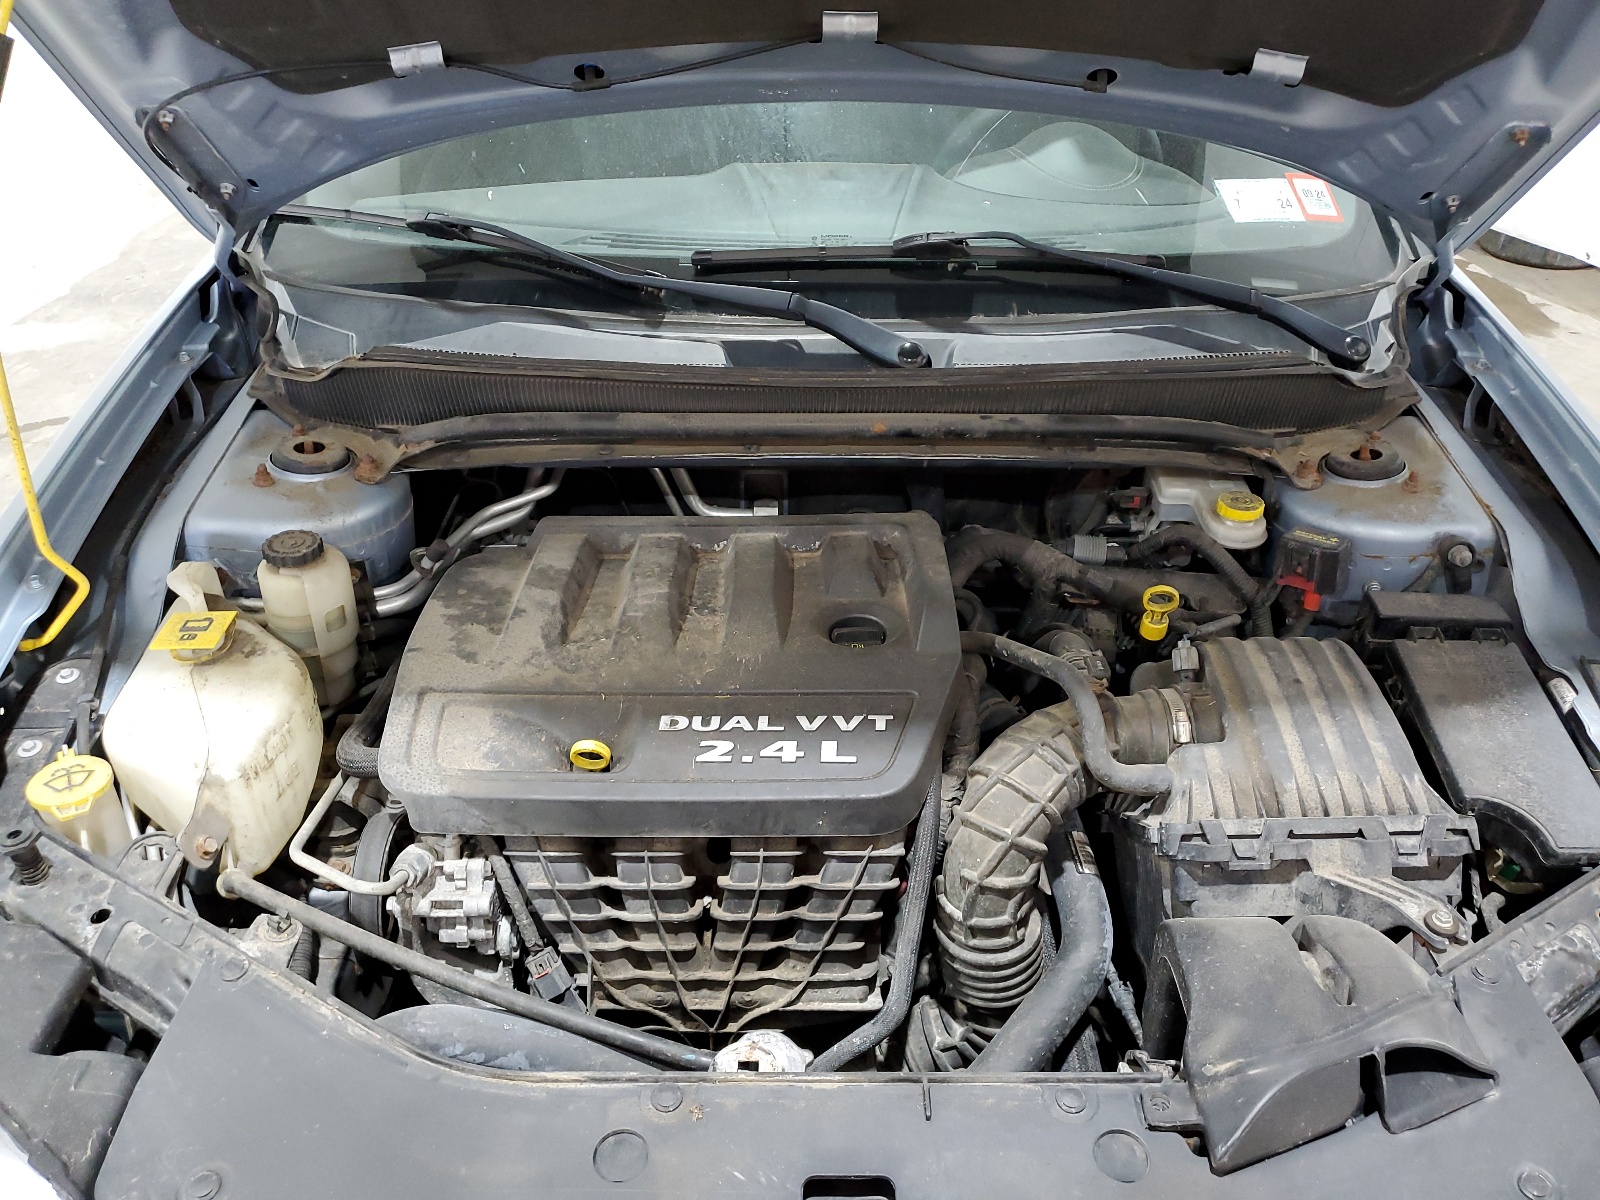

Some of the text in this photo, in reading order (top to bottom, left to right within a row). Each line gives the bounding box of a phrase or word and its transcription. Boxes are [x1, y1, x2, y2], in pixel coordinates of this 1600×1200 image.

[1277, 198, 1293, 209] 24
[658, 713, 894, 732] DUAL VVT
